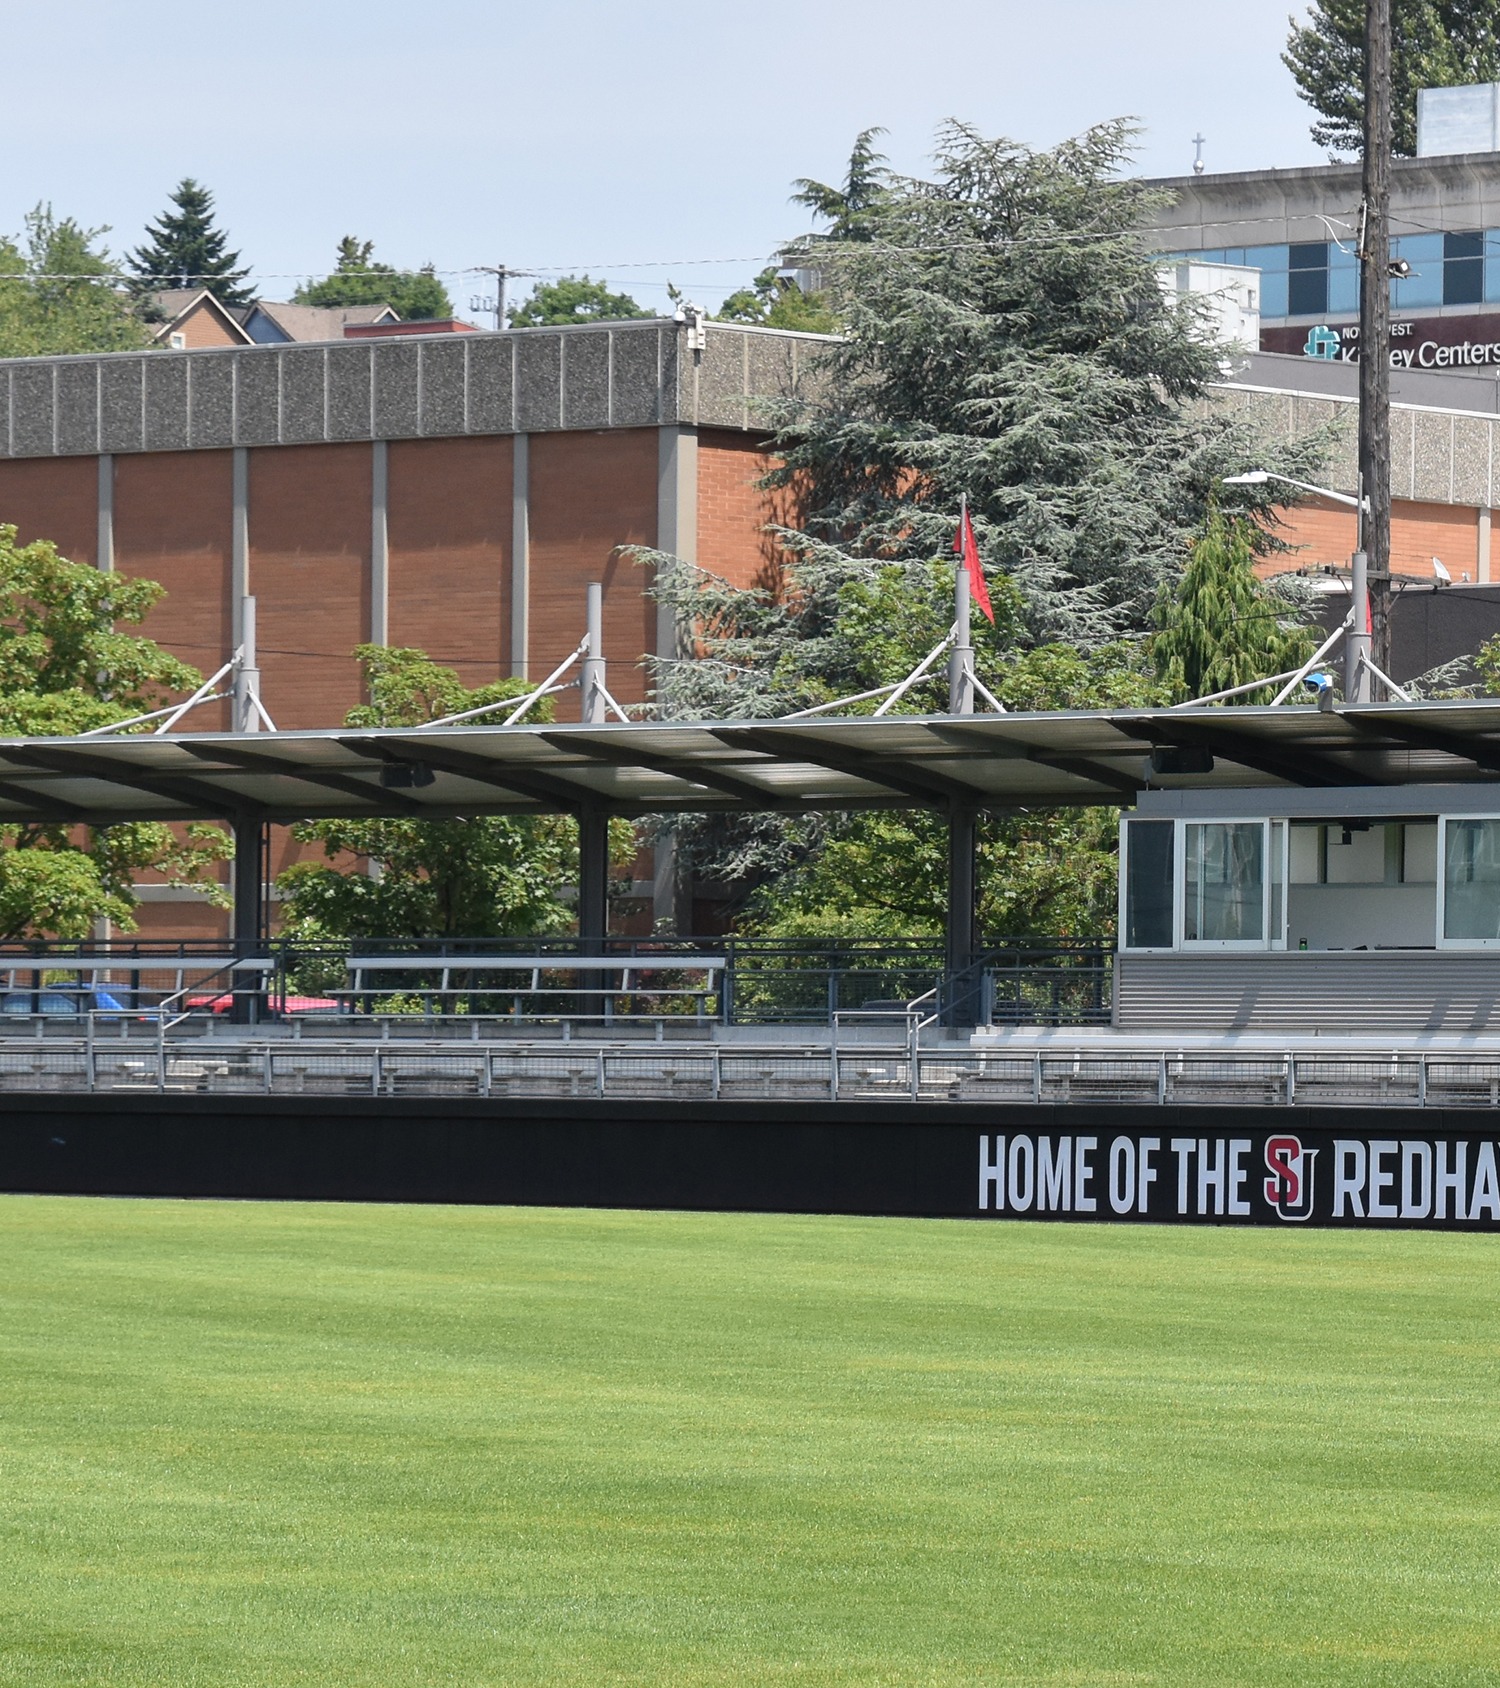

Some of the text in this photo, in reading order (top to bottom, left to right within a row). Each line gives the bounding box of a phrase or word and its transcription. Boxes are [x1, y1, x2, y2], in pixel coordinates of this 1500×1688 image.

[1342, 323, 1413, 339] NOEST
[978, 1135, 1098, 1212] HOME
[1109, 1136, 1161, 1214] OF
[1170, 1138, 1252, 1216] THE
